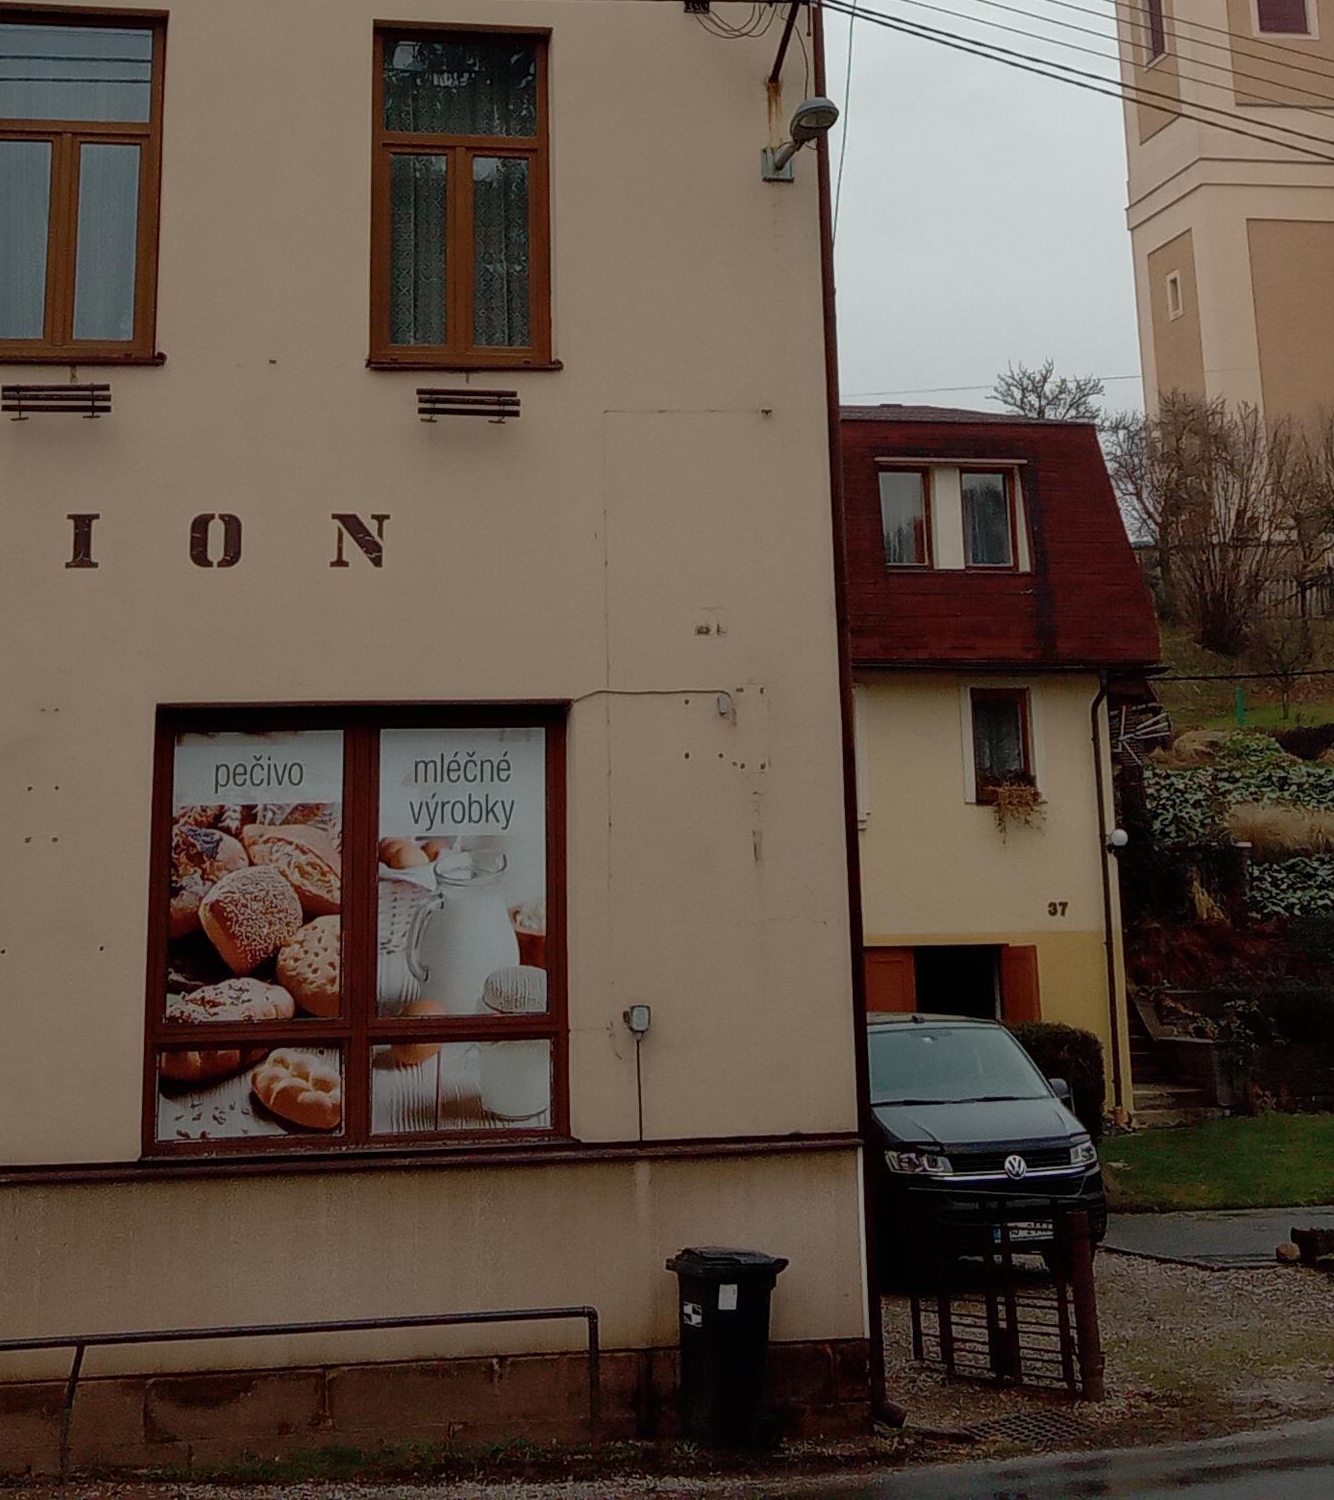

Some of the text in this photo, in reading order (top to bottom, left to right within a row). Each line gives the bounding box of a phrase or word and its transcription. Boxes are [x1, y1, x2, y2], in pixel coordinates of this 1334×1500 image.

[214, 754, 304, 794] pečivo
[414, 751, 511, 784] mléčné
[410, 793, 515, 832] výrobky
[1047, 901, 1068, 917] 37
